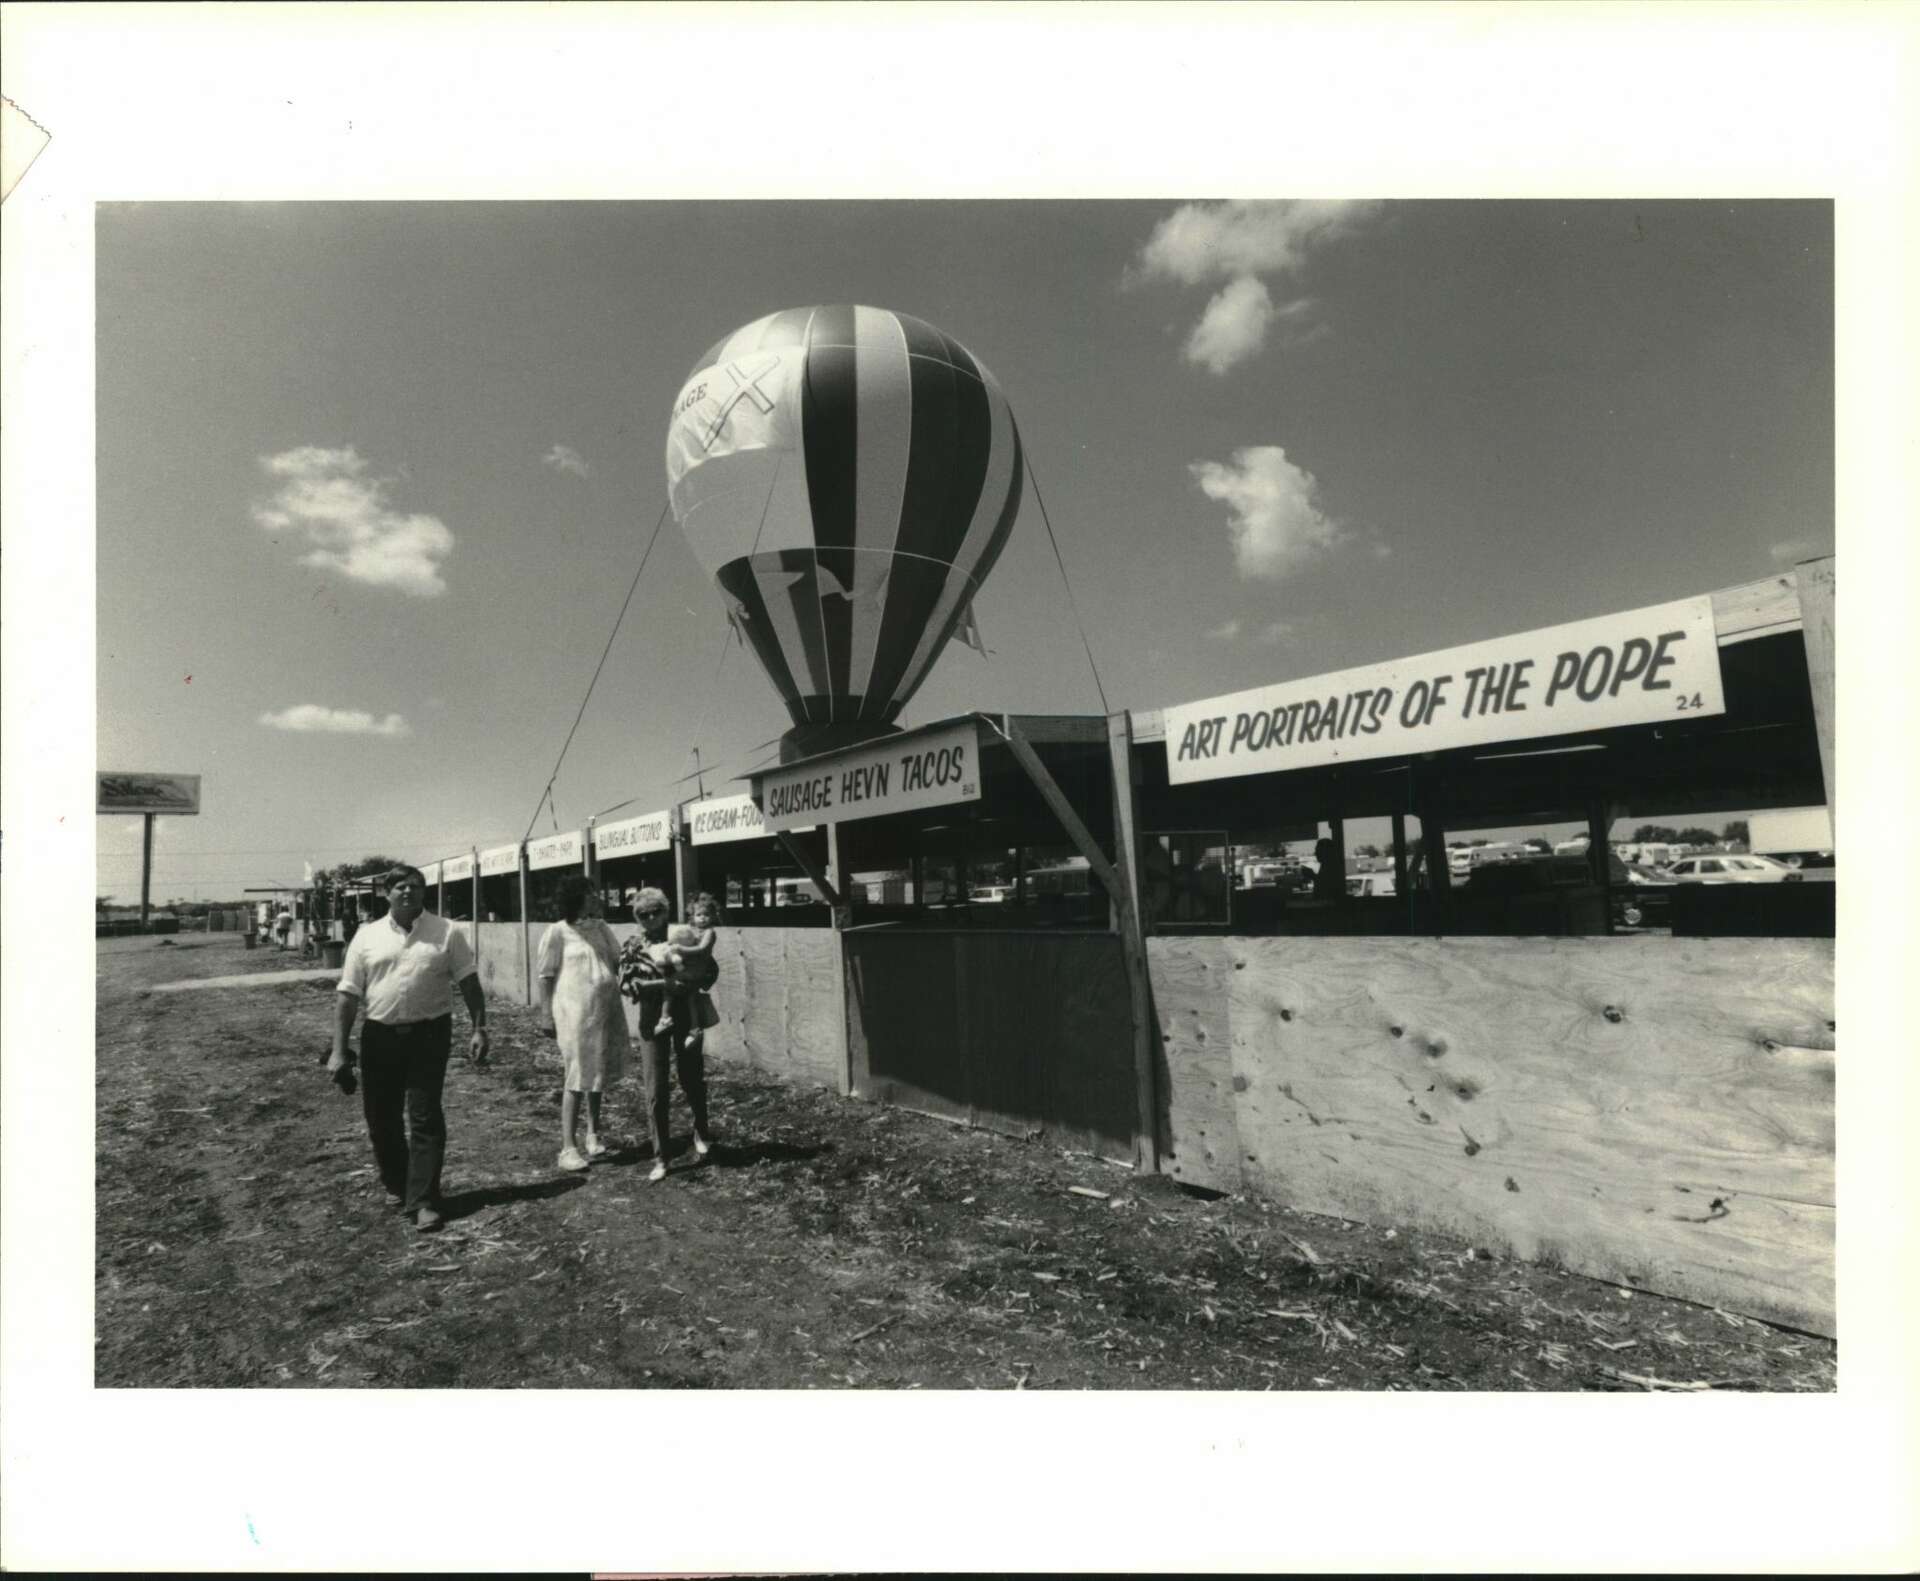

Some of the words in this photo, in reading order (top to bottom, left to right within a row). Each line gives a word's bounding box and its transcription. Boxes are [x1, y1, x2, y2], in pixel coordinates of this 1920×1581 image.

[1177, 716, 1227, 762] ART
[1229, 686, 1393, 754] PORTRAITS
[1399, 674, 1453, 729] OF
[1462, 659, 1534, 718] THE
[1545, 630, 1686, 707] POPE
[1676, 691, 1704, 711] 24
[769, 775, 833, 818] SAUSAGE
[901, 746, 964, 792] TACOS
